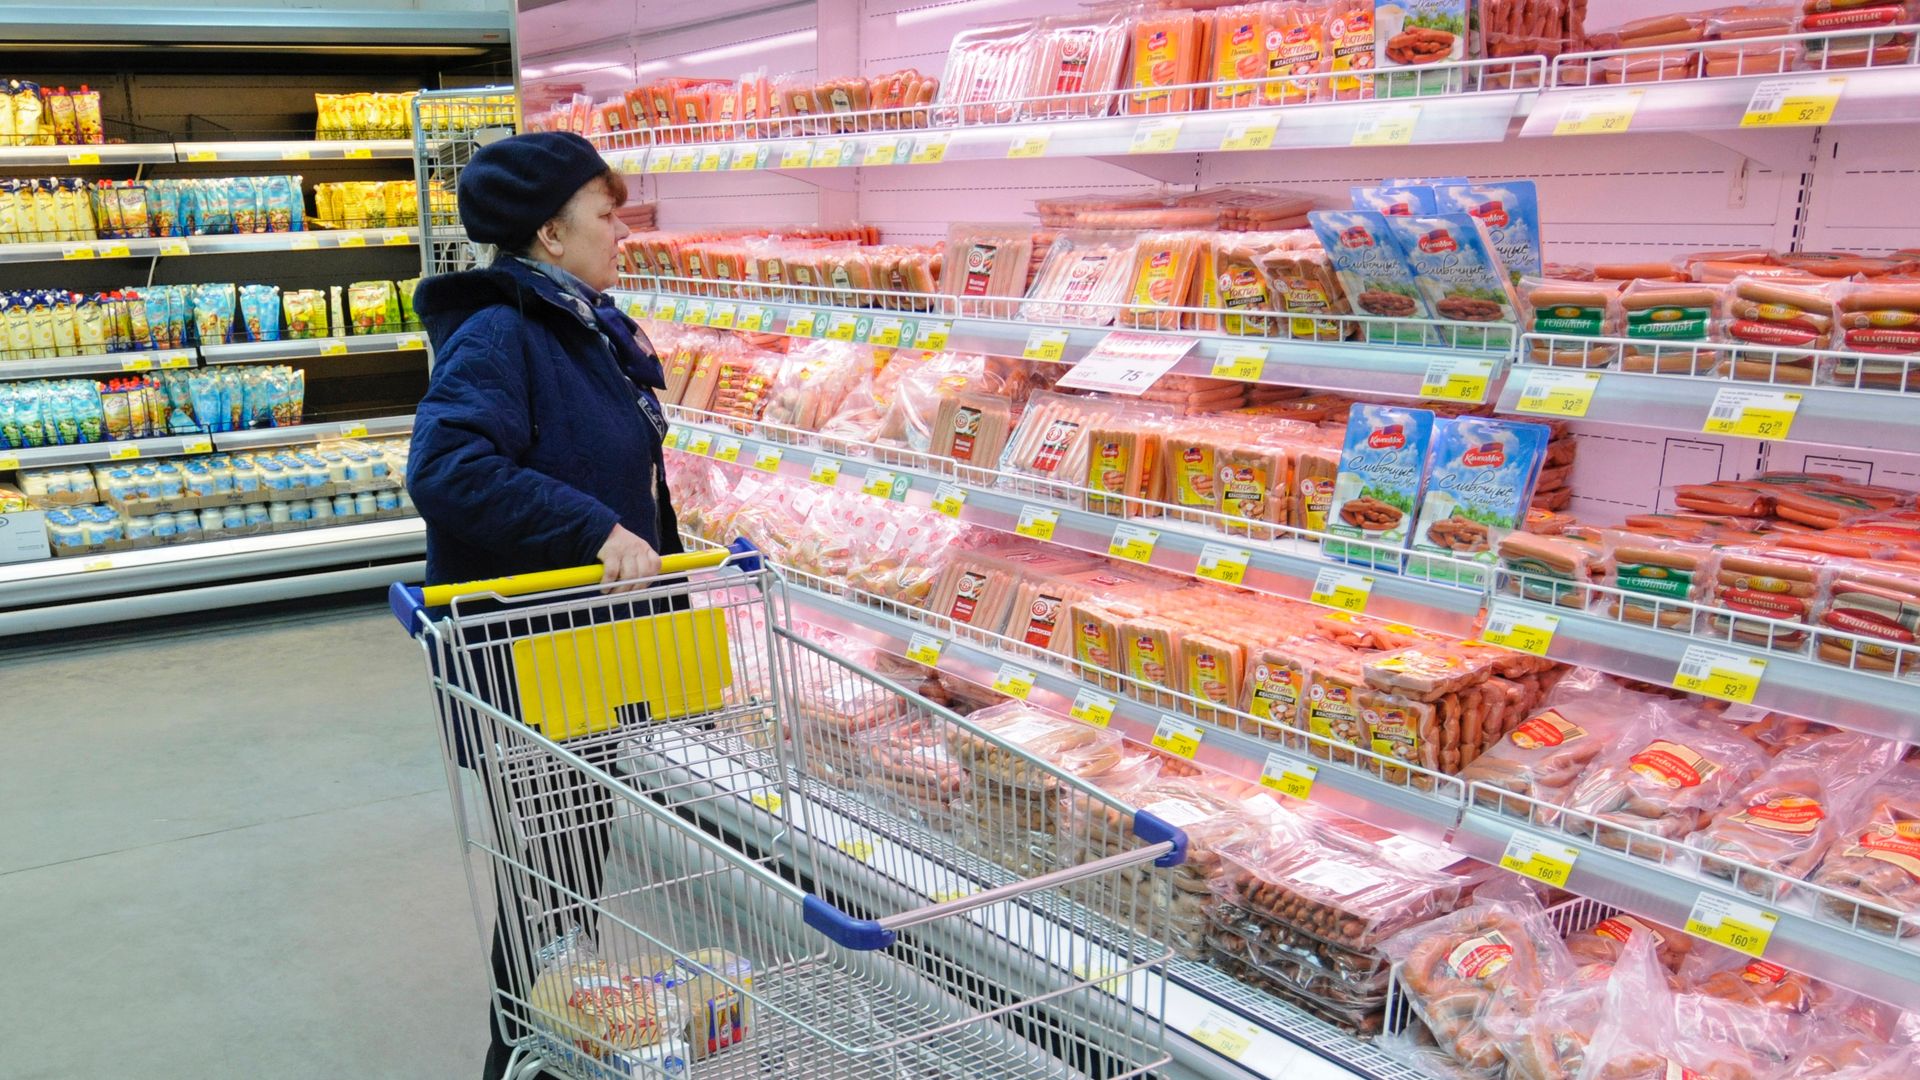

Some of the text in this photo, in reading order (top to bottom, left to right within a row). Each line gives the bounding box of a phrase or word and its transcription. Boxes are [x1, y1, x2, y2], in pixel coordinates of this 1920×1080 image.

[1337, 43, 1374, 56] КЛАССИЧЕСКИ
[1797, 109, 1813, 121] 52
[1601, 118, 1615, 130] 32
[1415, 254, 1487, 278] Сливочные
[1119, 368, 1144, 382] 75
[1239, 367, 1252, 378] 199
[1460, 385, 1471, 398] 85
[1562, 399, 1574, 411] 32
[1758, 422, 1773, 434] 52
[1369, 435, 1403, 447] КампоМос
[1347, 450, 1417, 479] Сливочные
[1463, 453, 1502, 465] КампоМос
[1438, 470, 1515, 499] Сливочные
[1222, 570, 1234, 581] 199
[1344, 596, 1355, 608] 85
[1523, 638, 1536, 650] 32
[1723, 683, 1738, 696] 52
[1287, 783, 1299, 795] 199
[1537, 866, 1554, 880] 160
[1729, 933, 1748, 948] 160
